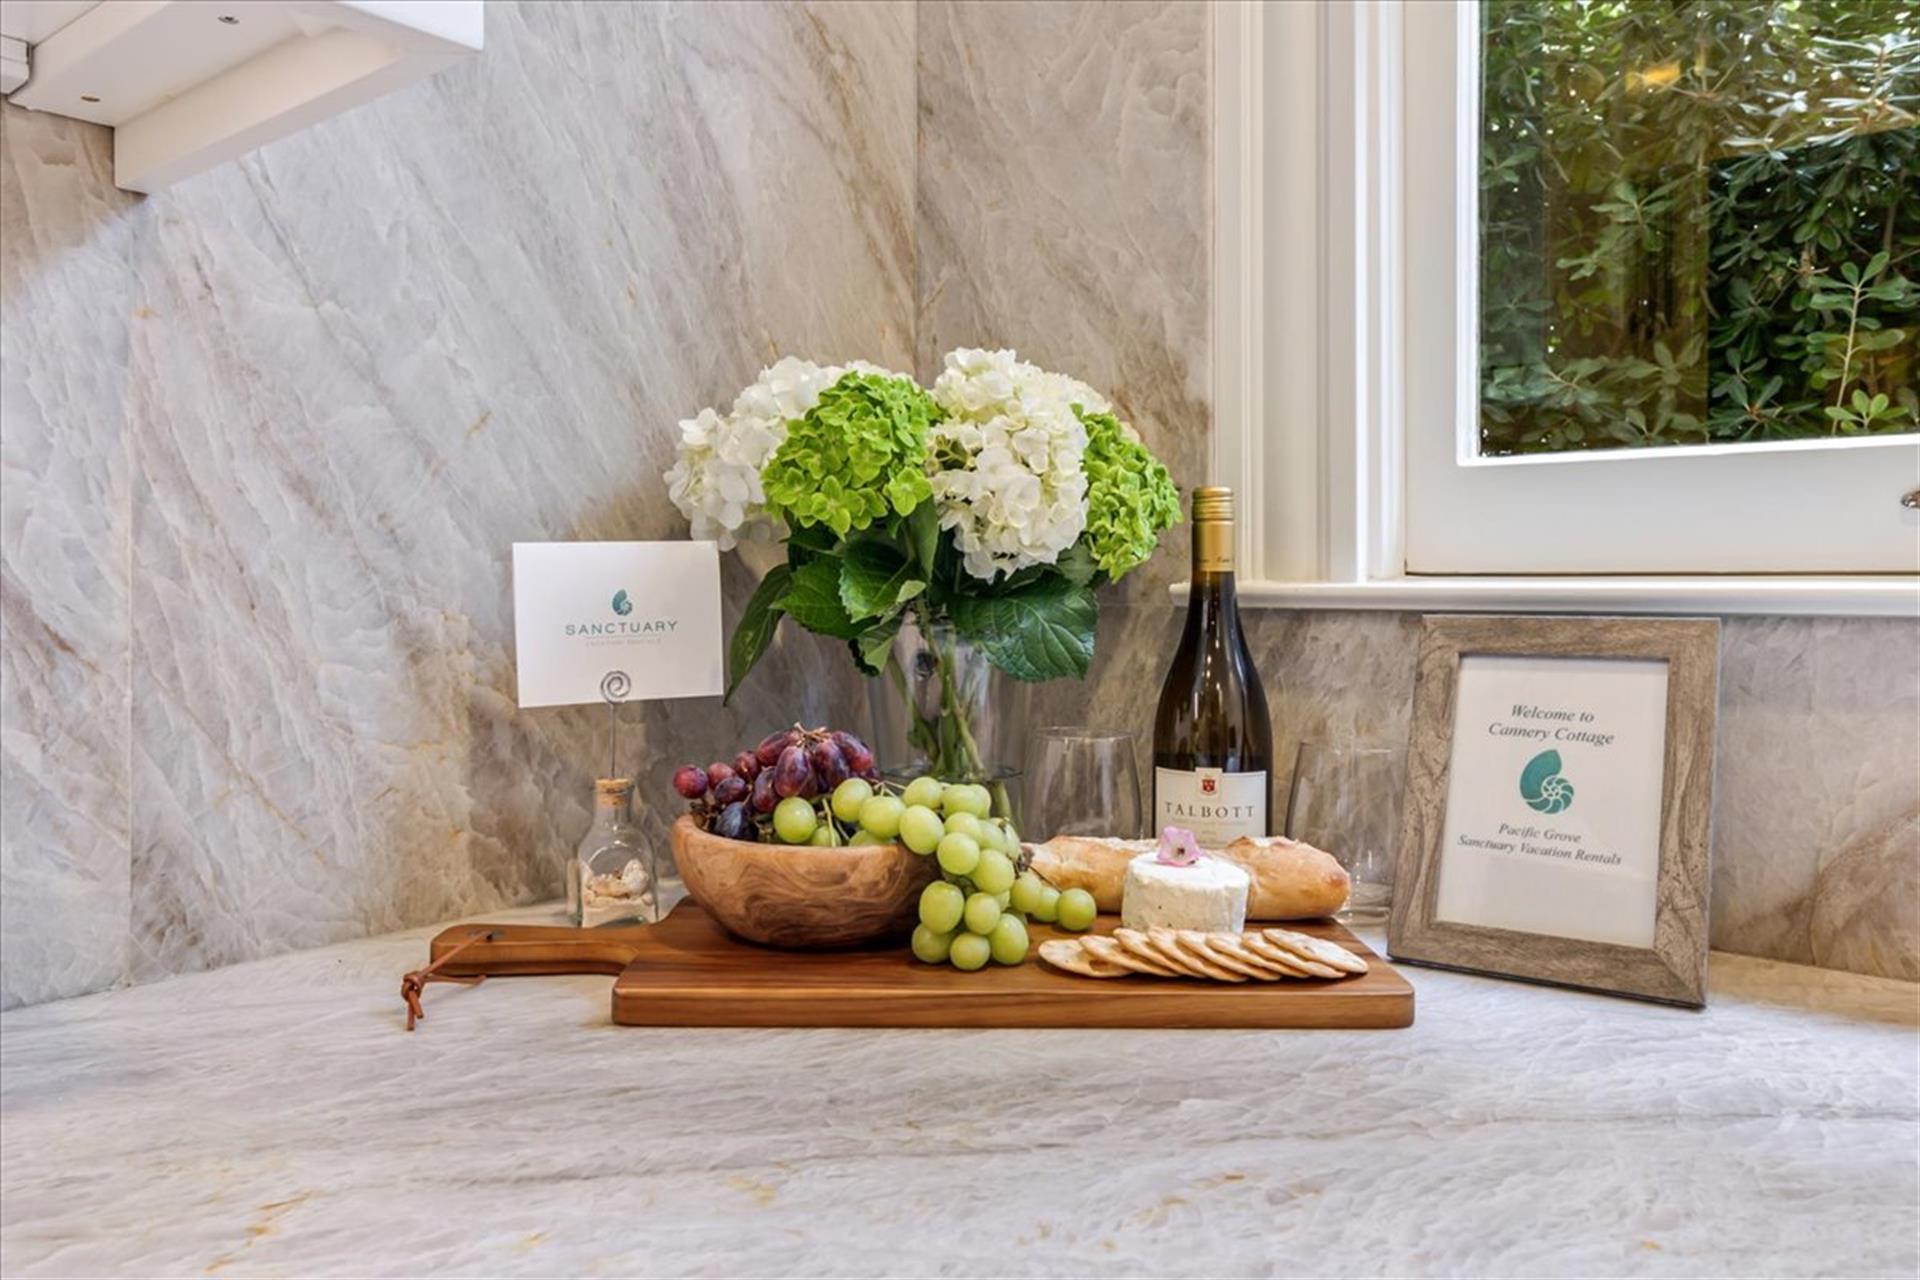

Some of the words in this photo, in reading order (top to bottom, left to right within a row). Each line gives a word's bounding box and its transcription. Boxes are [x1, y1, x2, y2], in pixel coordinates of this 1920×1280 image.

[565, 620, 678, 636] SANCTUARY
[1511, 704, 1575, 722] Welcome
[1579, 711, 1595, 723] to
[1488, 722, 1551, 742] Cannery
[1554, 727, 1615, 747] Cottage
[1164, 802, 1255, 818] TALBOTT
[1498, 823, 1541, 839] Pacific
[1543, 829, 1582, 843] Grove
[1457, 834, 1516, 853] Sanctuary
[1519, 842, 1573, 859] Vacation
[1574, 850, 1622, 865] Rentals
